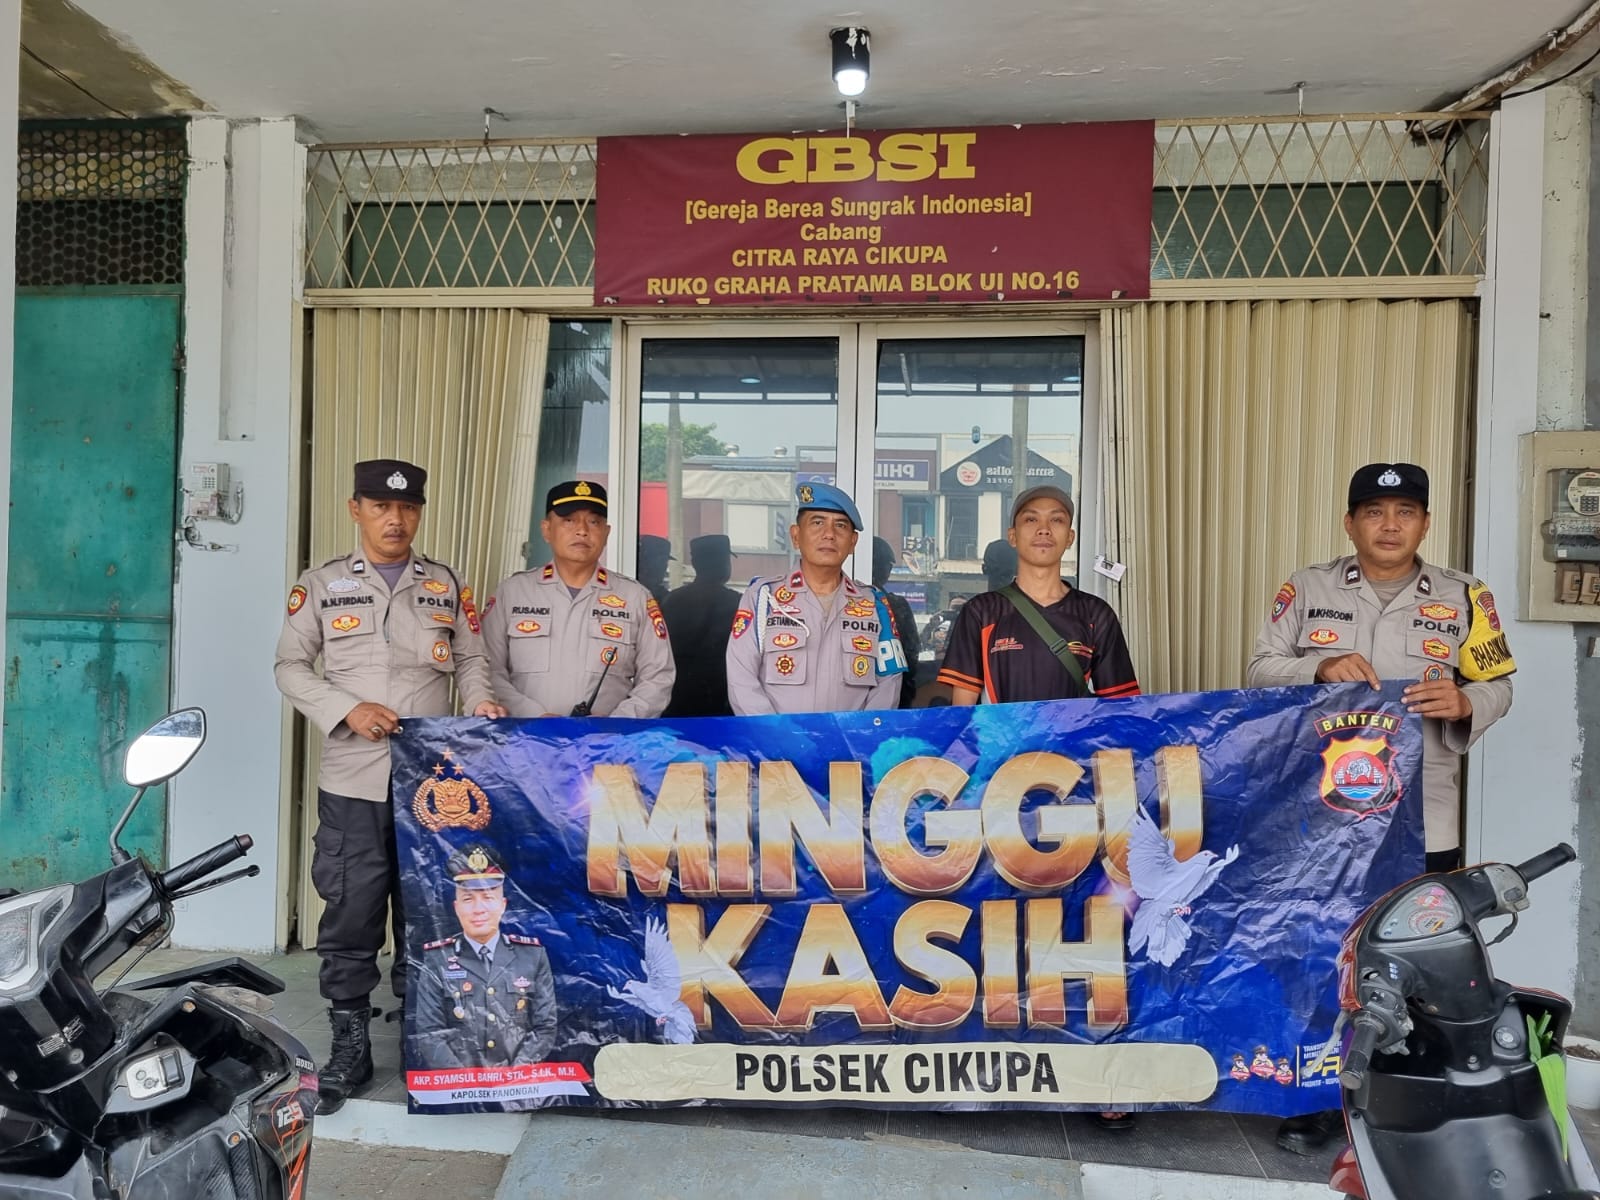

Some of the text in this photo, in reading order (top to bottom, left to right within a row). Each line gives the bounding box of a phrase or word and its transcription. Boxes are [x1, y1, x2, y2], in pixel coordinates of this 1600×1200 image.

[736, 133, 977, 185] GBSI
[685, 191, 1033, 225] [Gereja Berea Sungrak Indonesia]
[800, 223, 882, 244] Cabang
[732, 245, 948, 267] CITRA RAYA CIKUPA
[647, 276, 708, 297] RUKO
[714, 276, 791, 295] GRAHA
[798, 274, 904, 294] PRATAMA
[909, 273, 973, 292] BLOK
[1012, 270, 1080, 290] NO.16
[418, 596, 454, 610] POLRI
[512, 606, 551, 615] RUSANDI
[592, 608, 630, 619] POLRI
[842, 620, 879, 634] POLRI
[1413, 619, 1460, 637] POLRI
[1322, 714, 1395, 732] BANTEN
[586, 745, 1205, 900] MINGGU
[665, 896, 1131, 1034] KASIH
[434, 1073, 476, 1085] SYAMSUL
[736, 1051, 1060, 1094] POLSEK CIKUPA
[451, 1085, 540, 1100] KAPOLSEK PANONGAN
